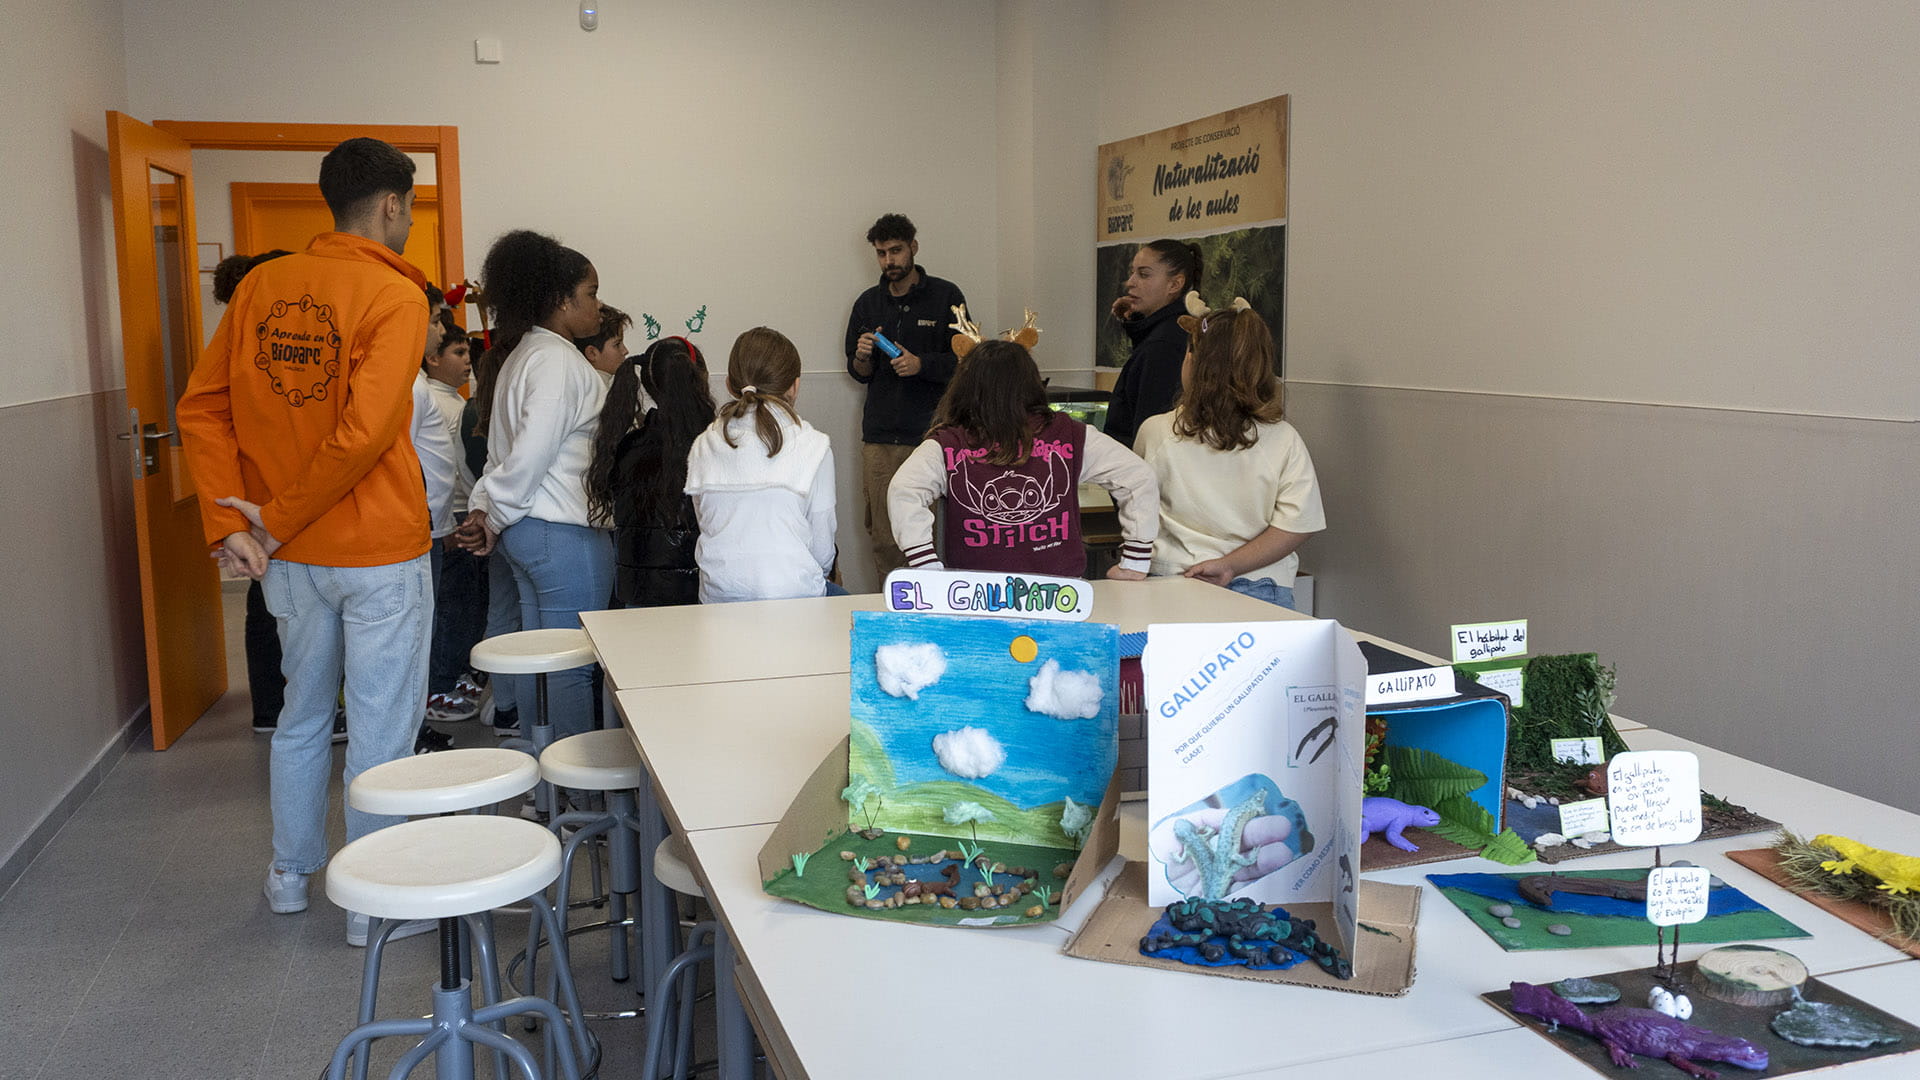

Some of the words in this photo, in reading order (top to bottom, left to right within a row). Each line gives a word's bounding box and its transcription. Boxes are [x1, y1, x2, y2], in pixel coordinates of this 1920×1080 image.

[1153, 144, 1261, 196] Naturalització
[1169, 198, 1184, 223] de
[1186, 196, 1203, 220] les
[1206, 190, 1240, 217] aules
[271, 328, 311, 342] Aprende
[314, 334, 325, 343] en
[891, 581, 933, 610] EL
[1457, 630, 1473, 643] El
[1512, 628, 1525, 641] del
[1470, 641, 1506, 659] gallipato
[1159, 631, 1256, 719] GALLIPATO
[1174, 742, 1189, 755] POR
[1188, 731, 1203, 745] QUE
[1201, 712, 1226, 734] QUIERO
[1224, 703, 1236, 714] UN
[1233, 674, 1264, 706] GALLIPATO
[1262, 666, 1272, 677] EN
[1270, 657, 1281, 668] MI
[1294, 695, 1306, 703] EL
[1613, 767, 1623, 781] El
[1292, 878, 1306, 891] VER
[1303, 859, 1321, 879] COMO
